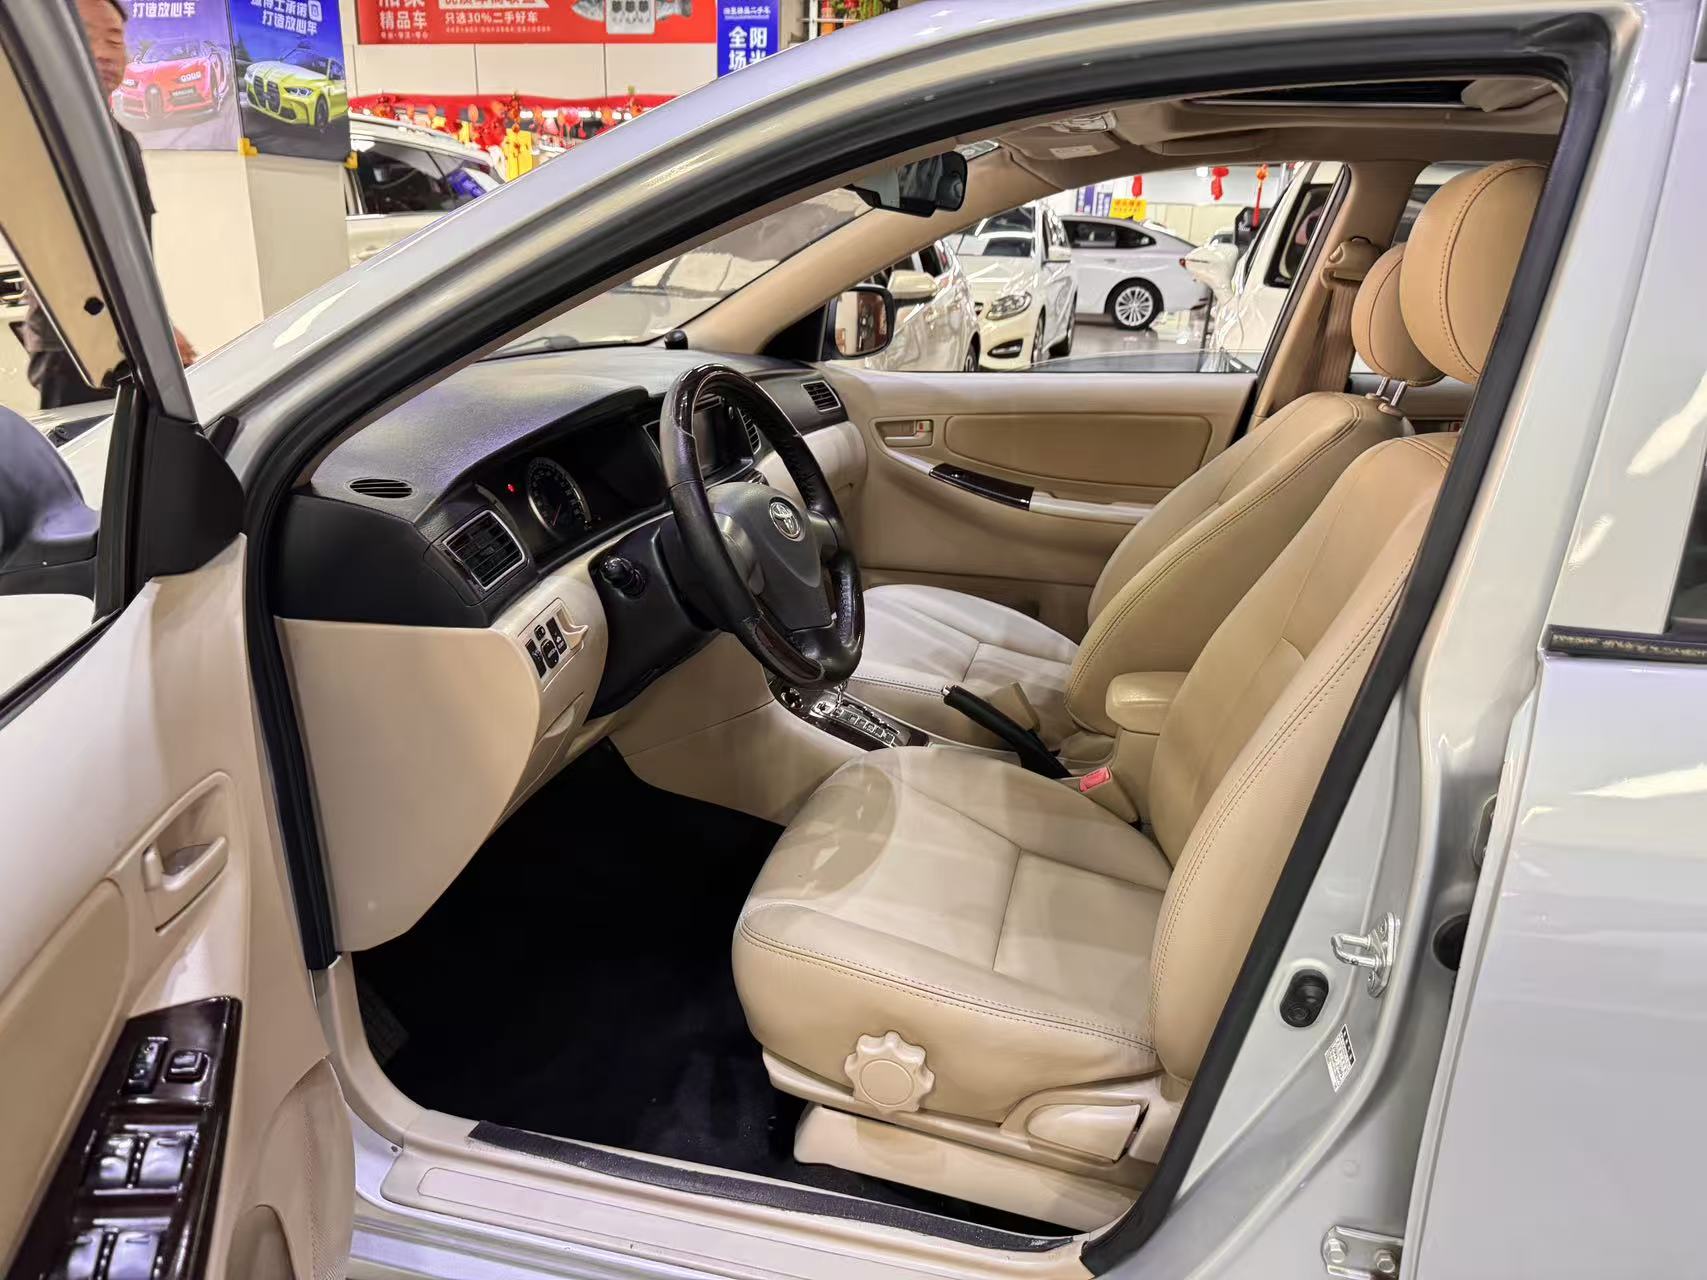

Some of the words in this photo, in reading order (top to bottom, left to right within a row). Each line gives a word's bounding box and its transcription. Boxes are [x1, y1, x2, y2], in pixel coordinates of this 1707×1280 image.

[133, 2, 196, 18] 打造放心车
[379, 10, 428, 30] 精品车
[262, 9, 318, 36] 打造放心车
